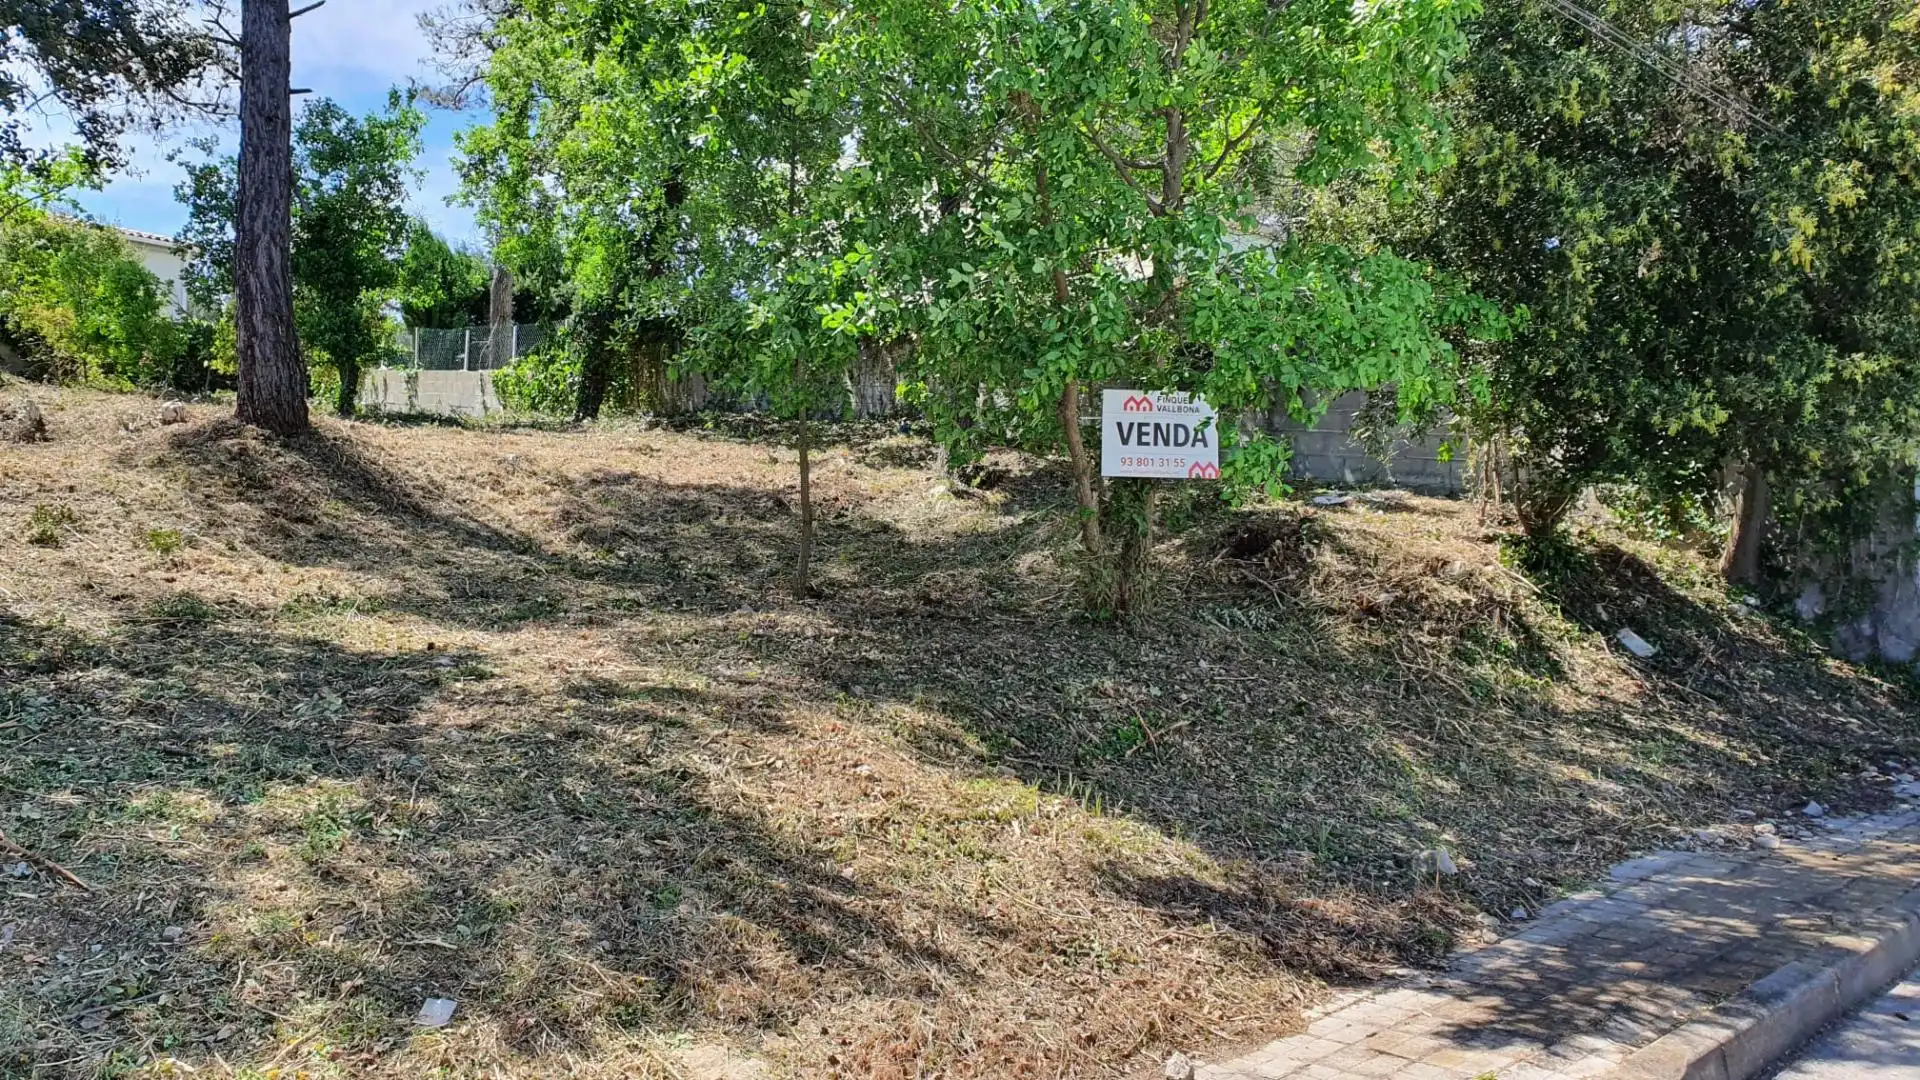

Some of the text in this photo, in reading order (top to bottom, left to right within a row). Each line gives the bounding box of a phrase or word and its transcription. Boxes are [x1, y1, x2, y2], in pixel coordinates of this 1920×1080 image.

[1156, 395, 1195, 405] FINQUE
[1157, 404, 1200, 413] VALLBONA
[1116, 421, 1209, 448] VENDA
[1120, 456, 1185, 468] 93 801 31 55
